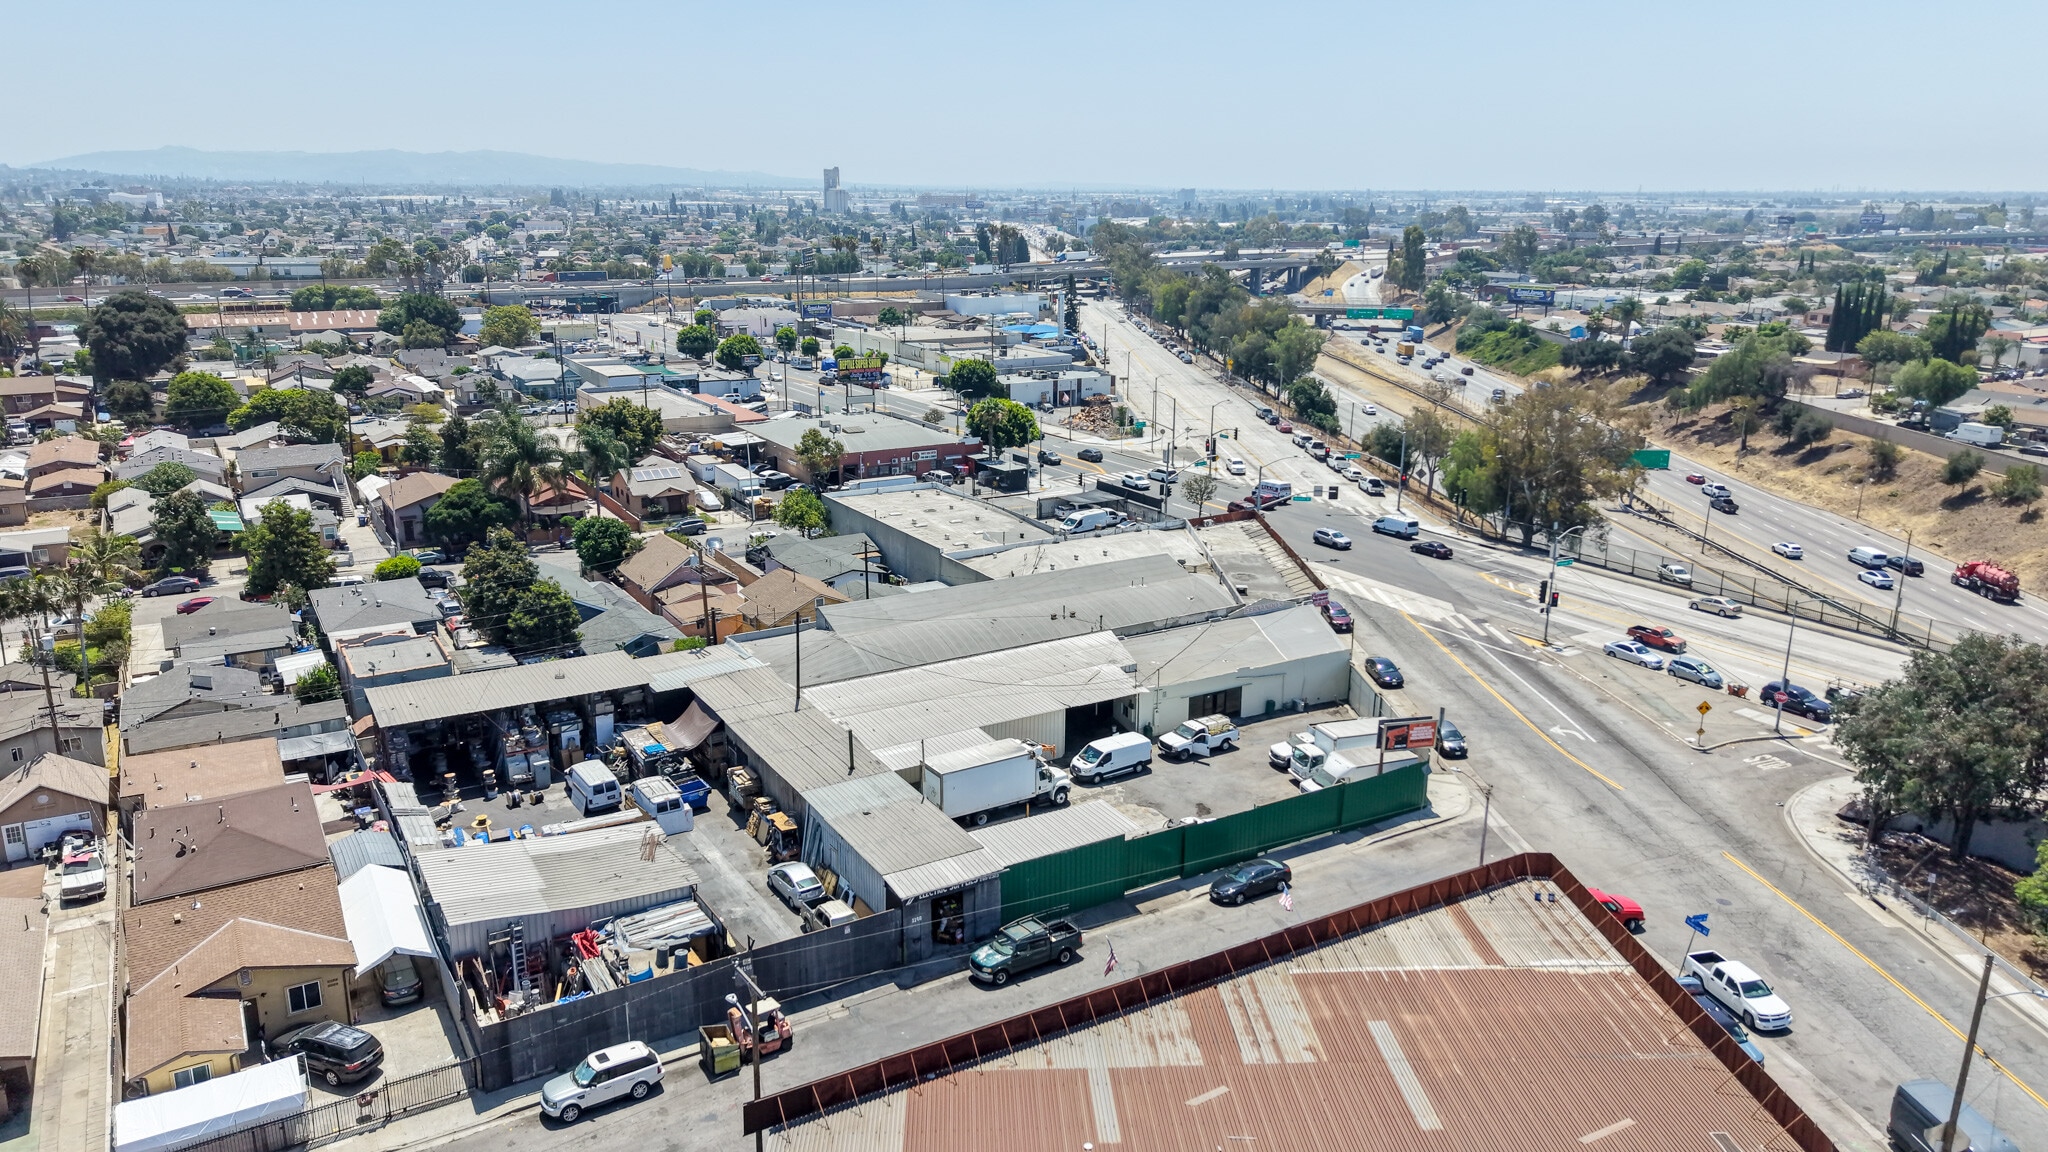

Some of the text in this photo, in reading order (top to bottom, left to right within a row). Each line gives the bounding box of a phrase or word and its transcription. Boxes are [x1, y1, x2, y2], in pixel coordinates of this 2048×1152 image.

[839, 359, 855, 370] REPTILE
[855, 359, 868, 369] SUPER
[1743, 754, 1792, 771] STOP
[918, 888, 948, 900] ELECTRIC
